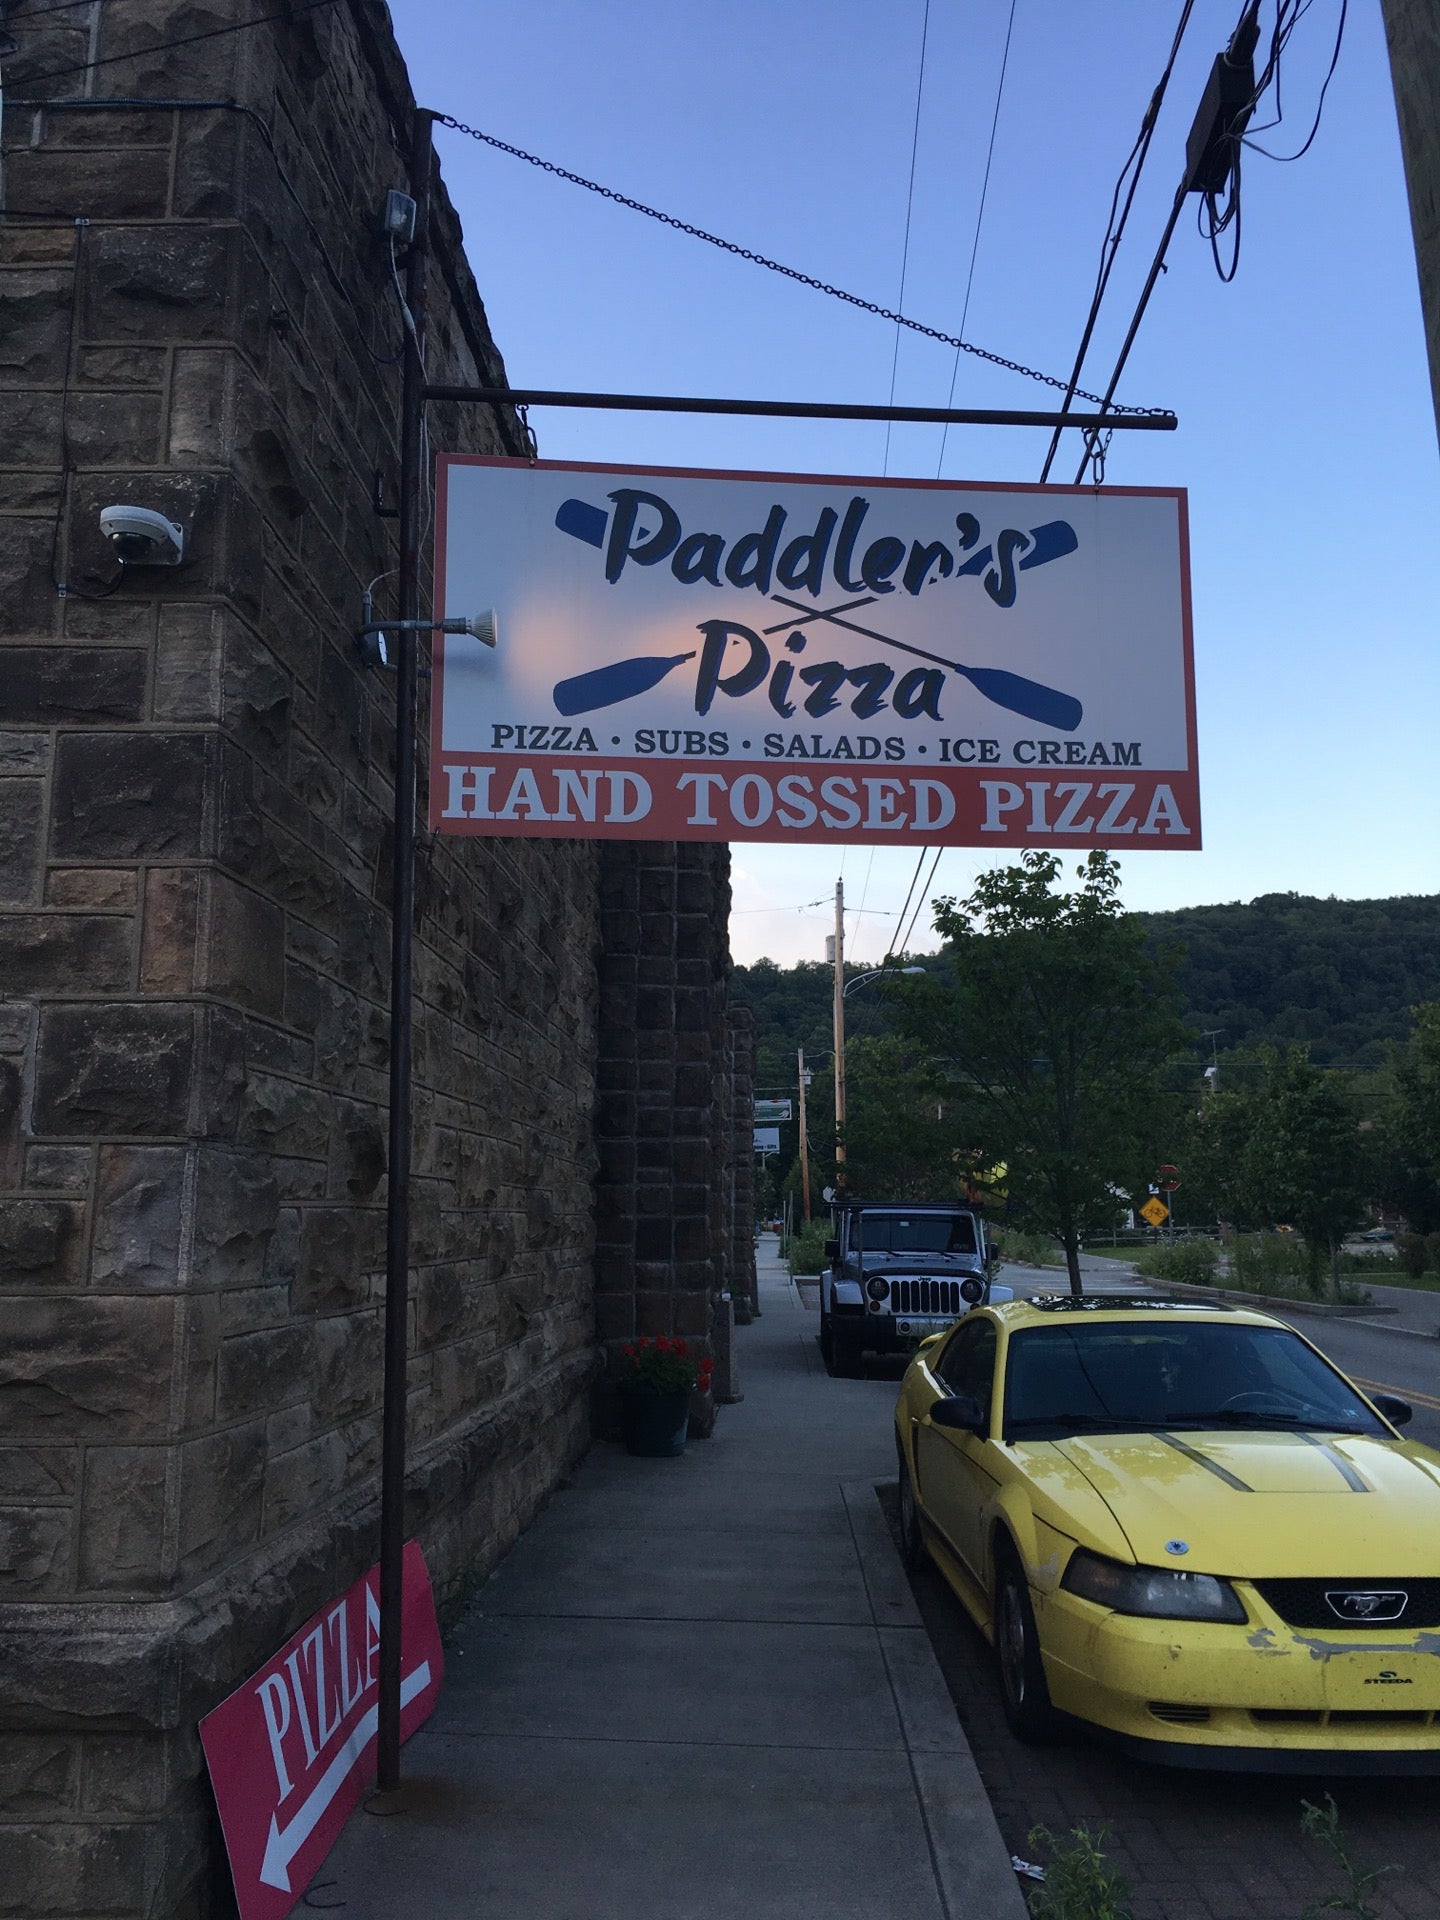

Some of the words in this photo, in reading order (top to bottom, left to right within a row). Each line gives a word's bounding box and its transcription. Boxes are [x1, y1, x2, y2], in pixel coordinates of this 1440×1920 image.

[605, 488, 1029, 608] Paddler's
[694, 619, 945, 721] Pizza
[491, 724, 598, 751] PIZZA
[634, 729, 730, 756] SUBS
[764, 733, 906, 761] SALADS
[939, 738, 1001, 763] ICE
[1013, 740, 1142, 767] CREAM
[442, 765, 653, 823] HAND
[675, 772, 957, 832] TOSSED
[979, 780, 1191, 836] PIZZA
[255, 1581, 382, 1807] PIZZA
